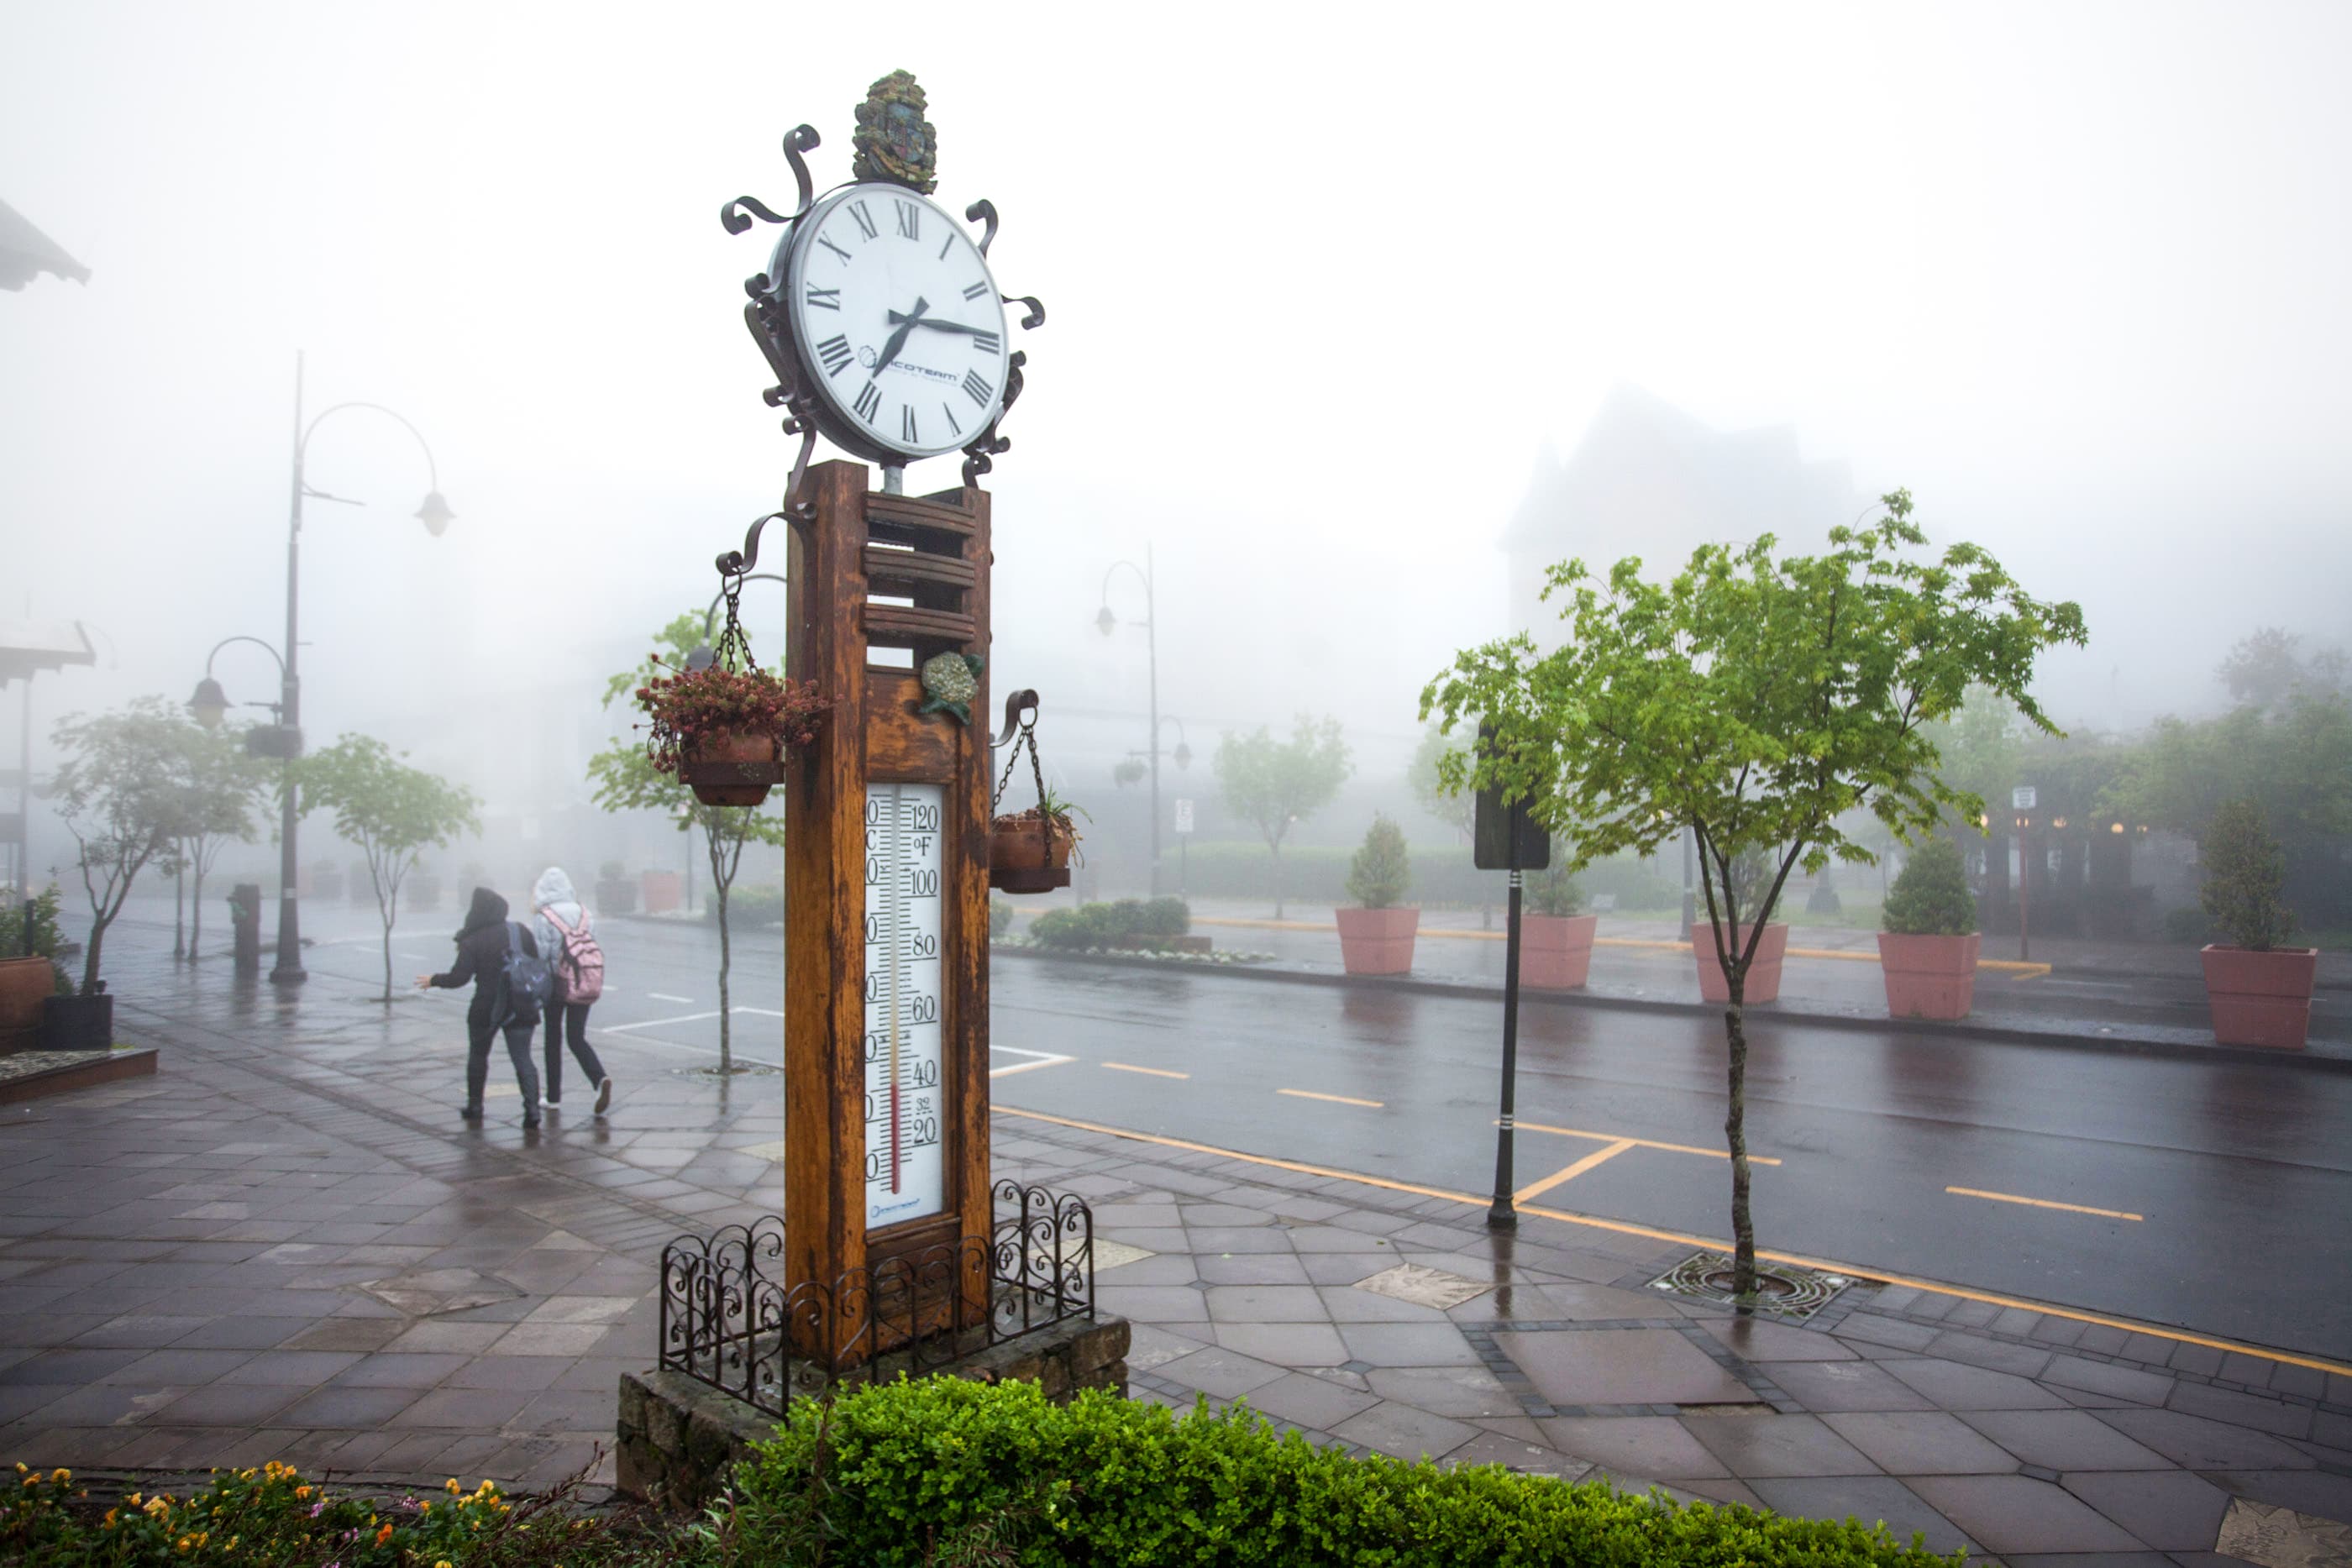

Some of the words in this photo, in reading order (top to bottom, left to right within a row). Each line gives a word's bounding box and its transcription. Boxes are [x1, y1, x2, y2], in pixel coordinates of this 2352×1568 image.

[847, 199, 879, 243] XI
[894, 198, 920, 242] XII
[817, 230, 852, 267] X
[938, 232, 956, 262] I
[806, 281, 840, 312] IX
[963, 280, 989, 302] II
[816, 333, 855, 379] VIII
[973, 333, 1000, 356] III
[852, 379, 882, 426] VII
[902, 404, 918, 443] VI
[943, 401, 962, 438] V
[911, 805, 938, 831] 120
[911, 869, 937, 895] 100
[913, 934, 935, 957] 80
[912, 994, 935, 1022] 60
[913, 1059, 936, 1086] 40
[916, 1096, 930, 1112] 32
[913, 1116, 937, 1144] 20
